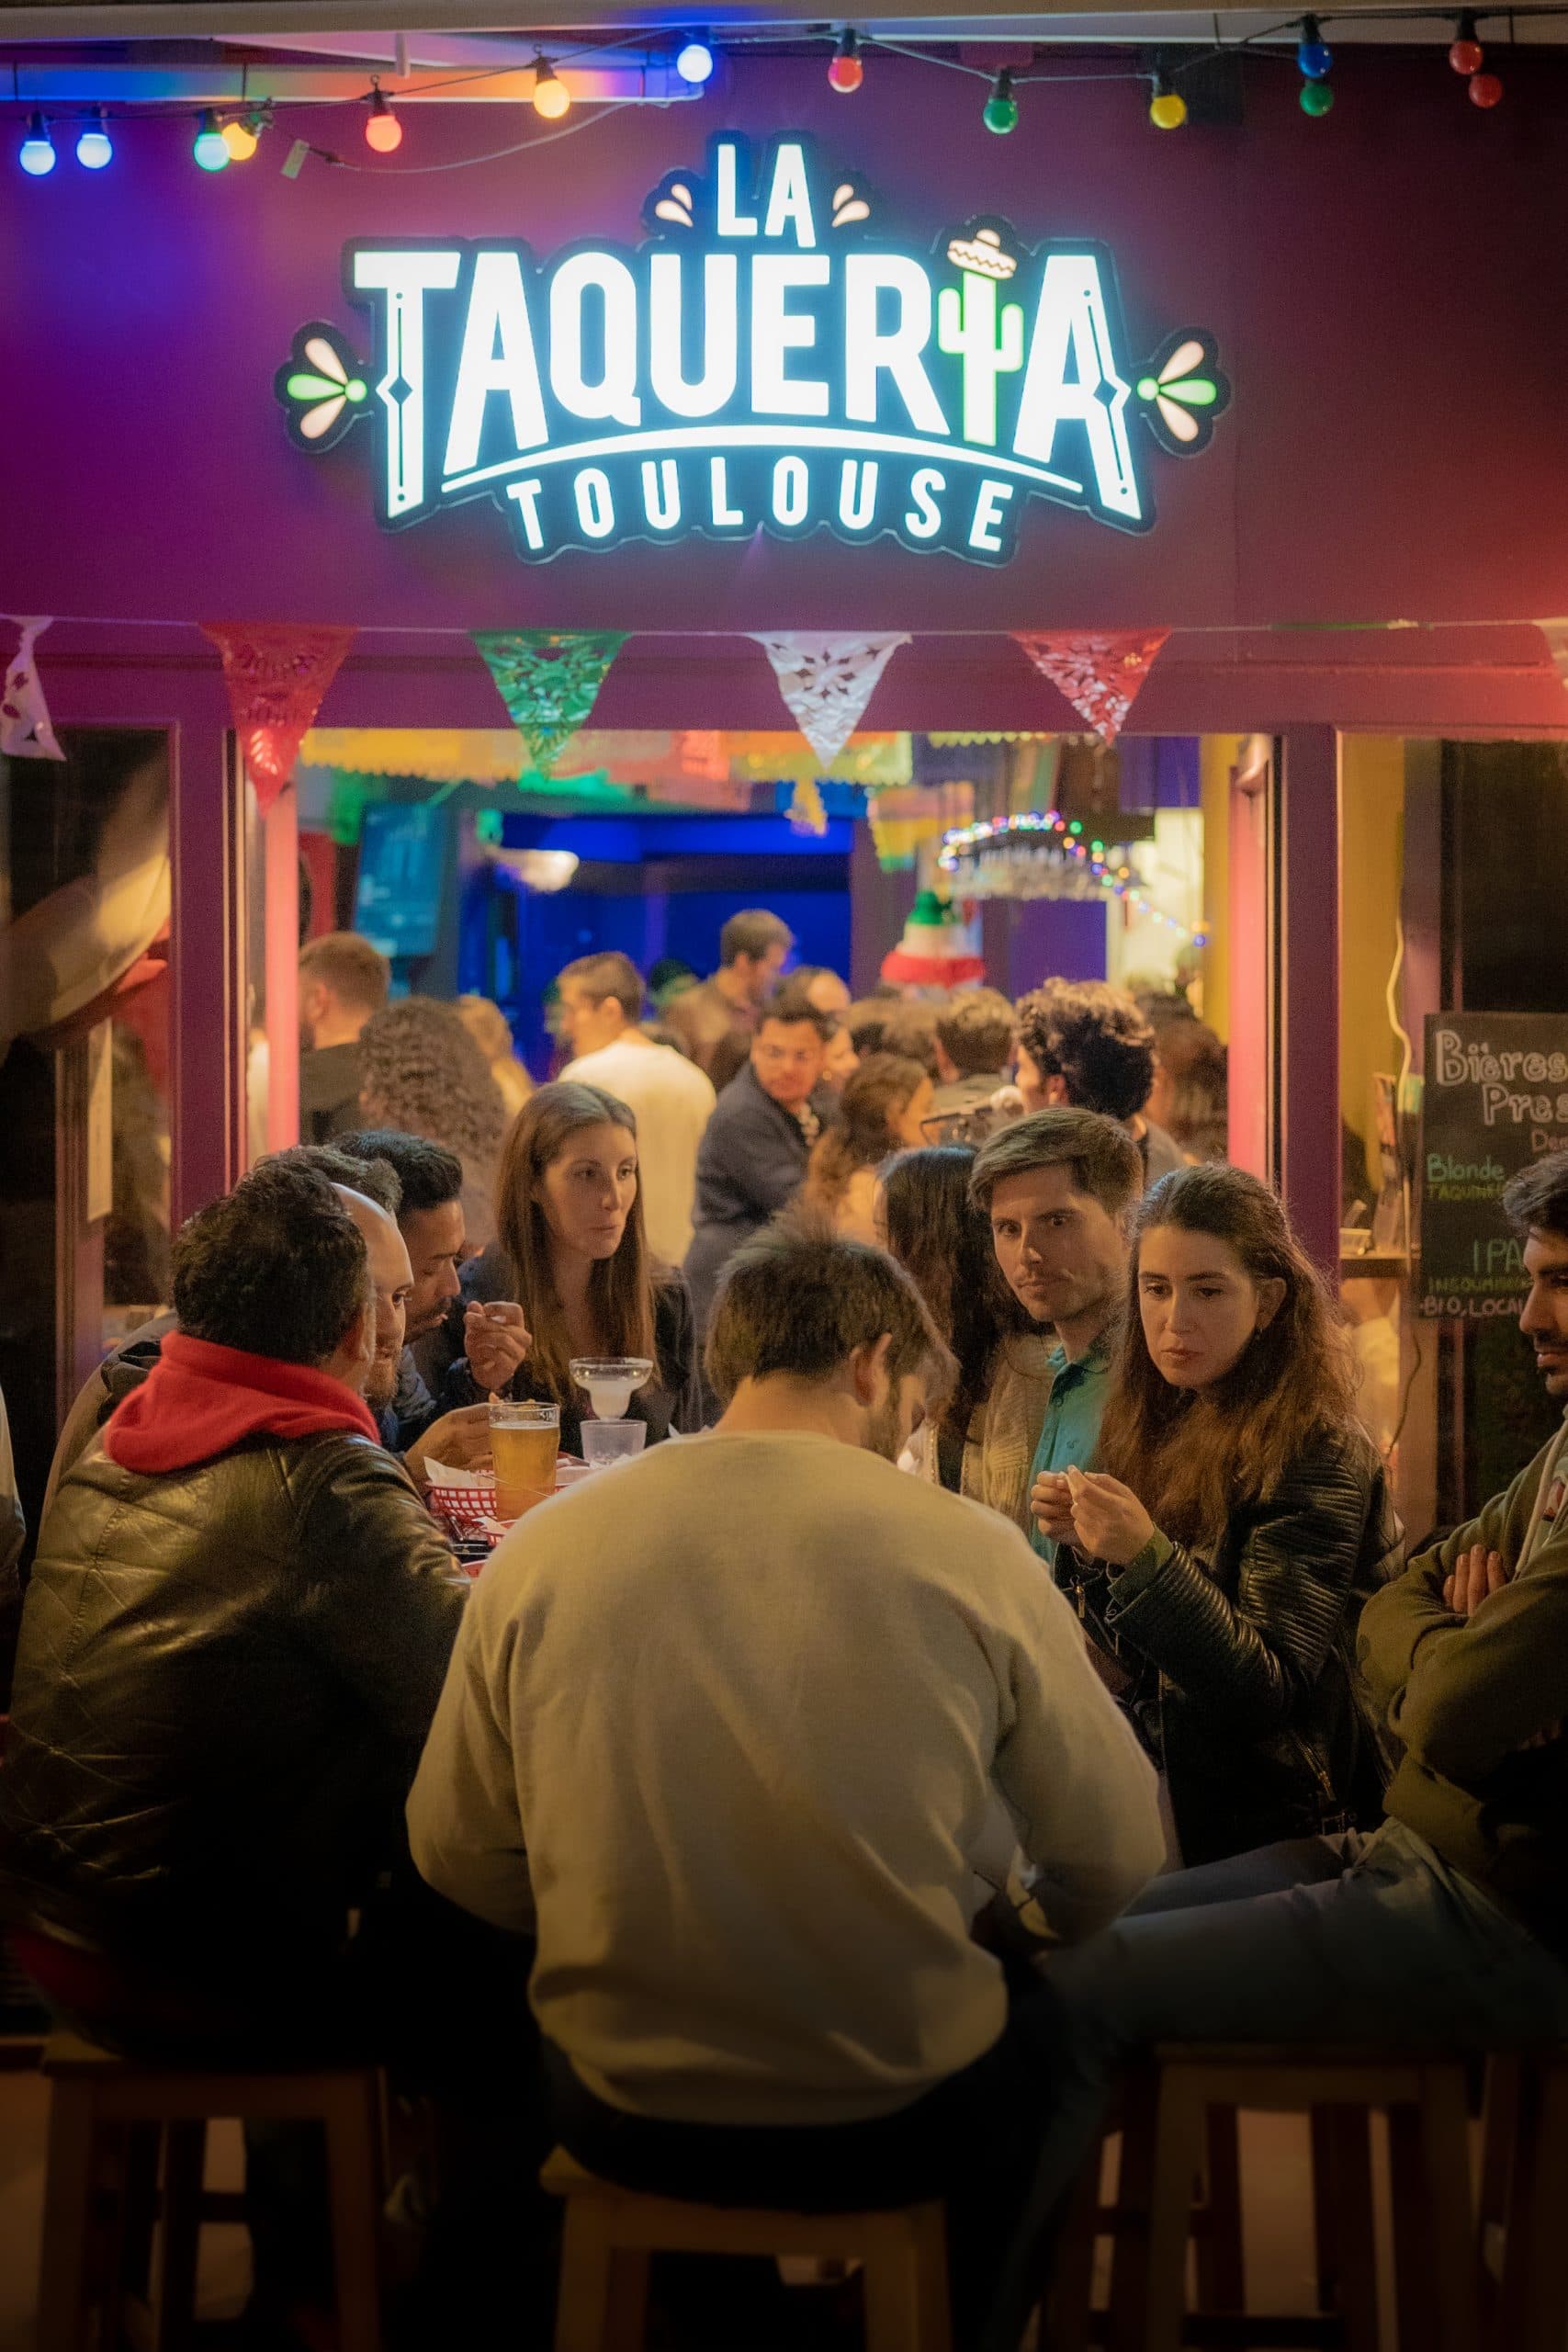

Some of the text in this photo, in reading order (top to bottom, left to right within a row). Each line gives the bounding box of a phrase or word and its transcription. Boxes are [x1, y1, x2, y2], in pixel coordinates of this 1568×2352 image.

[716, 142, 816, 248] LA
[353, 230, 1142, 520] TAQUERIA
[506, 454, 1013, 552] TOULOUSE
[1427, 1152, 1505, 1182] Blonde
[1473, 1238, 1524, 1273] IPA
